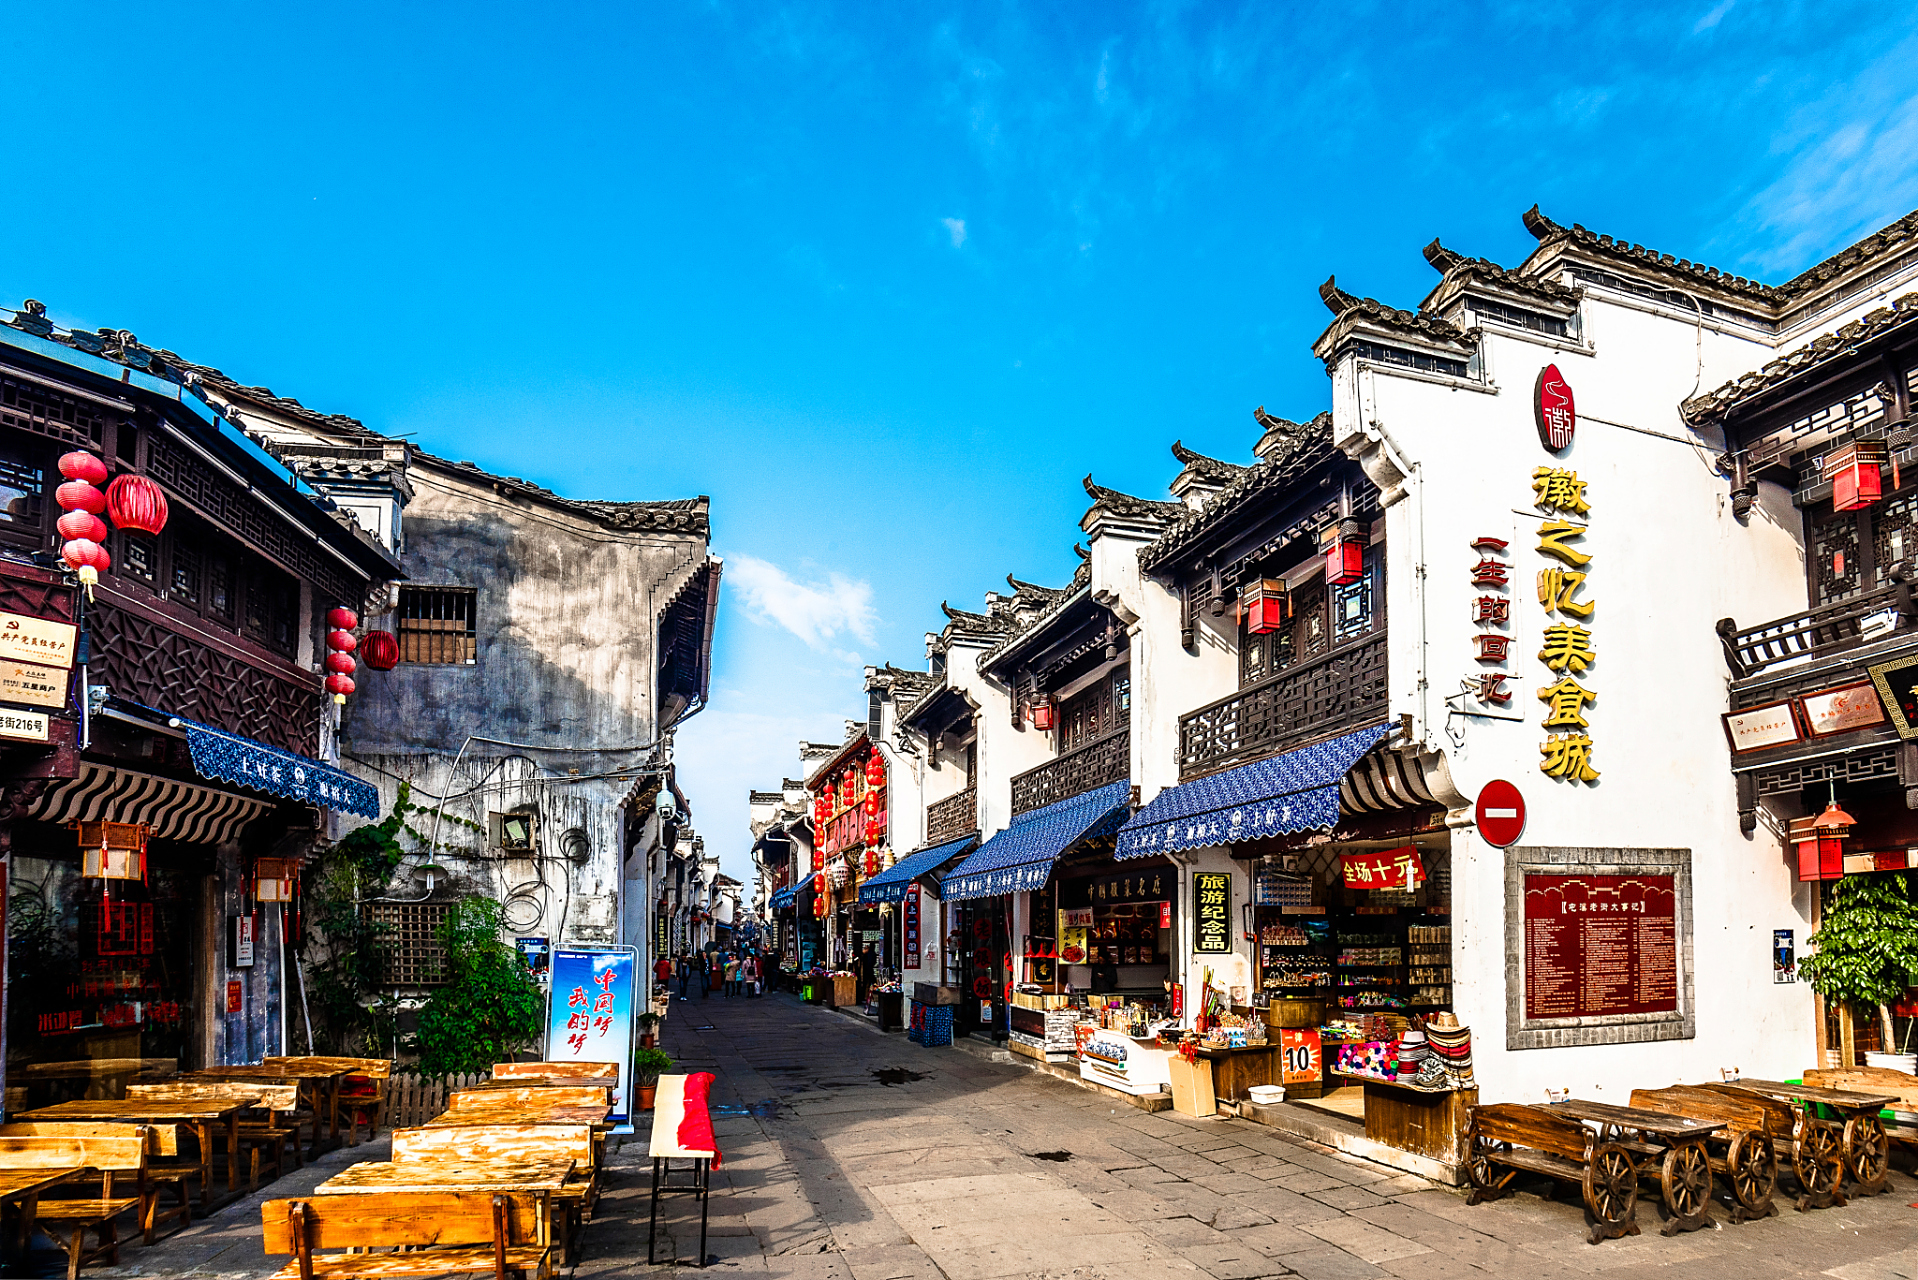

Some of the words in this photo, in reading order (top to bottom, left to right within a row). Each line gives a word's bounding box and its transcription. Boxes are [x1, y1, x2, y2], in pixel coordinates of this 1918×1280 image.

[0, 632, 66, 651] 共产党员经营户
[1470, 536, 1513, 704] 一生的回忆
[1531, 465, 1601, 782] 徽之忆美食城
[1343, 854, 1420, 883] 全场十元
[1199, 875, 1227, 950] 旅游纪念品
[566, 985, 591, 1055] 我的梦
[593, 968, 618, 1037] 中国梦
[1284, 1046, 1309, 1072] 10
